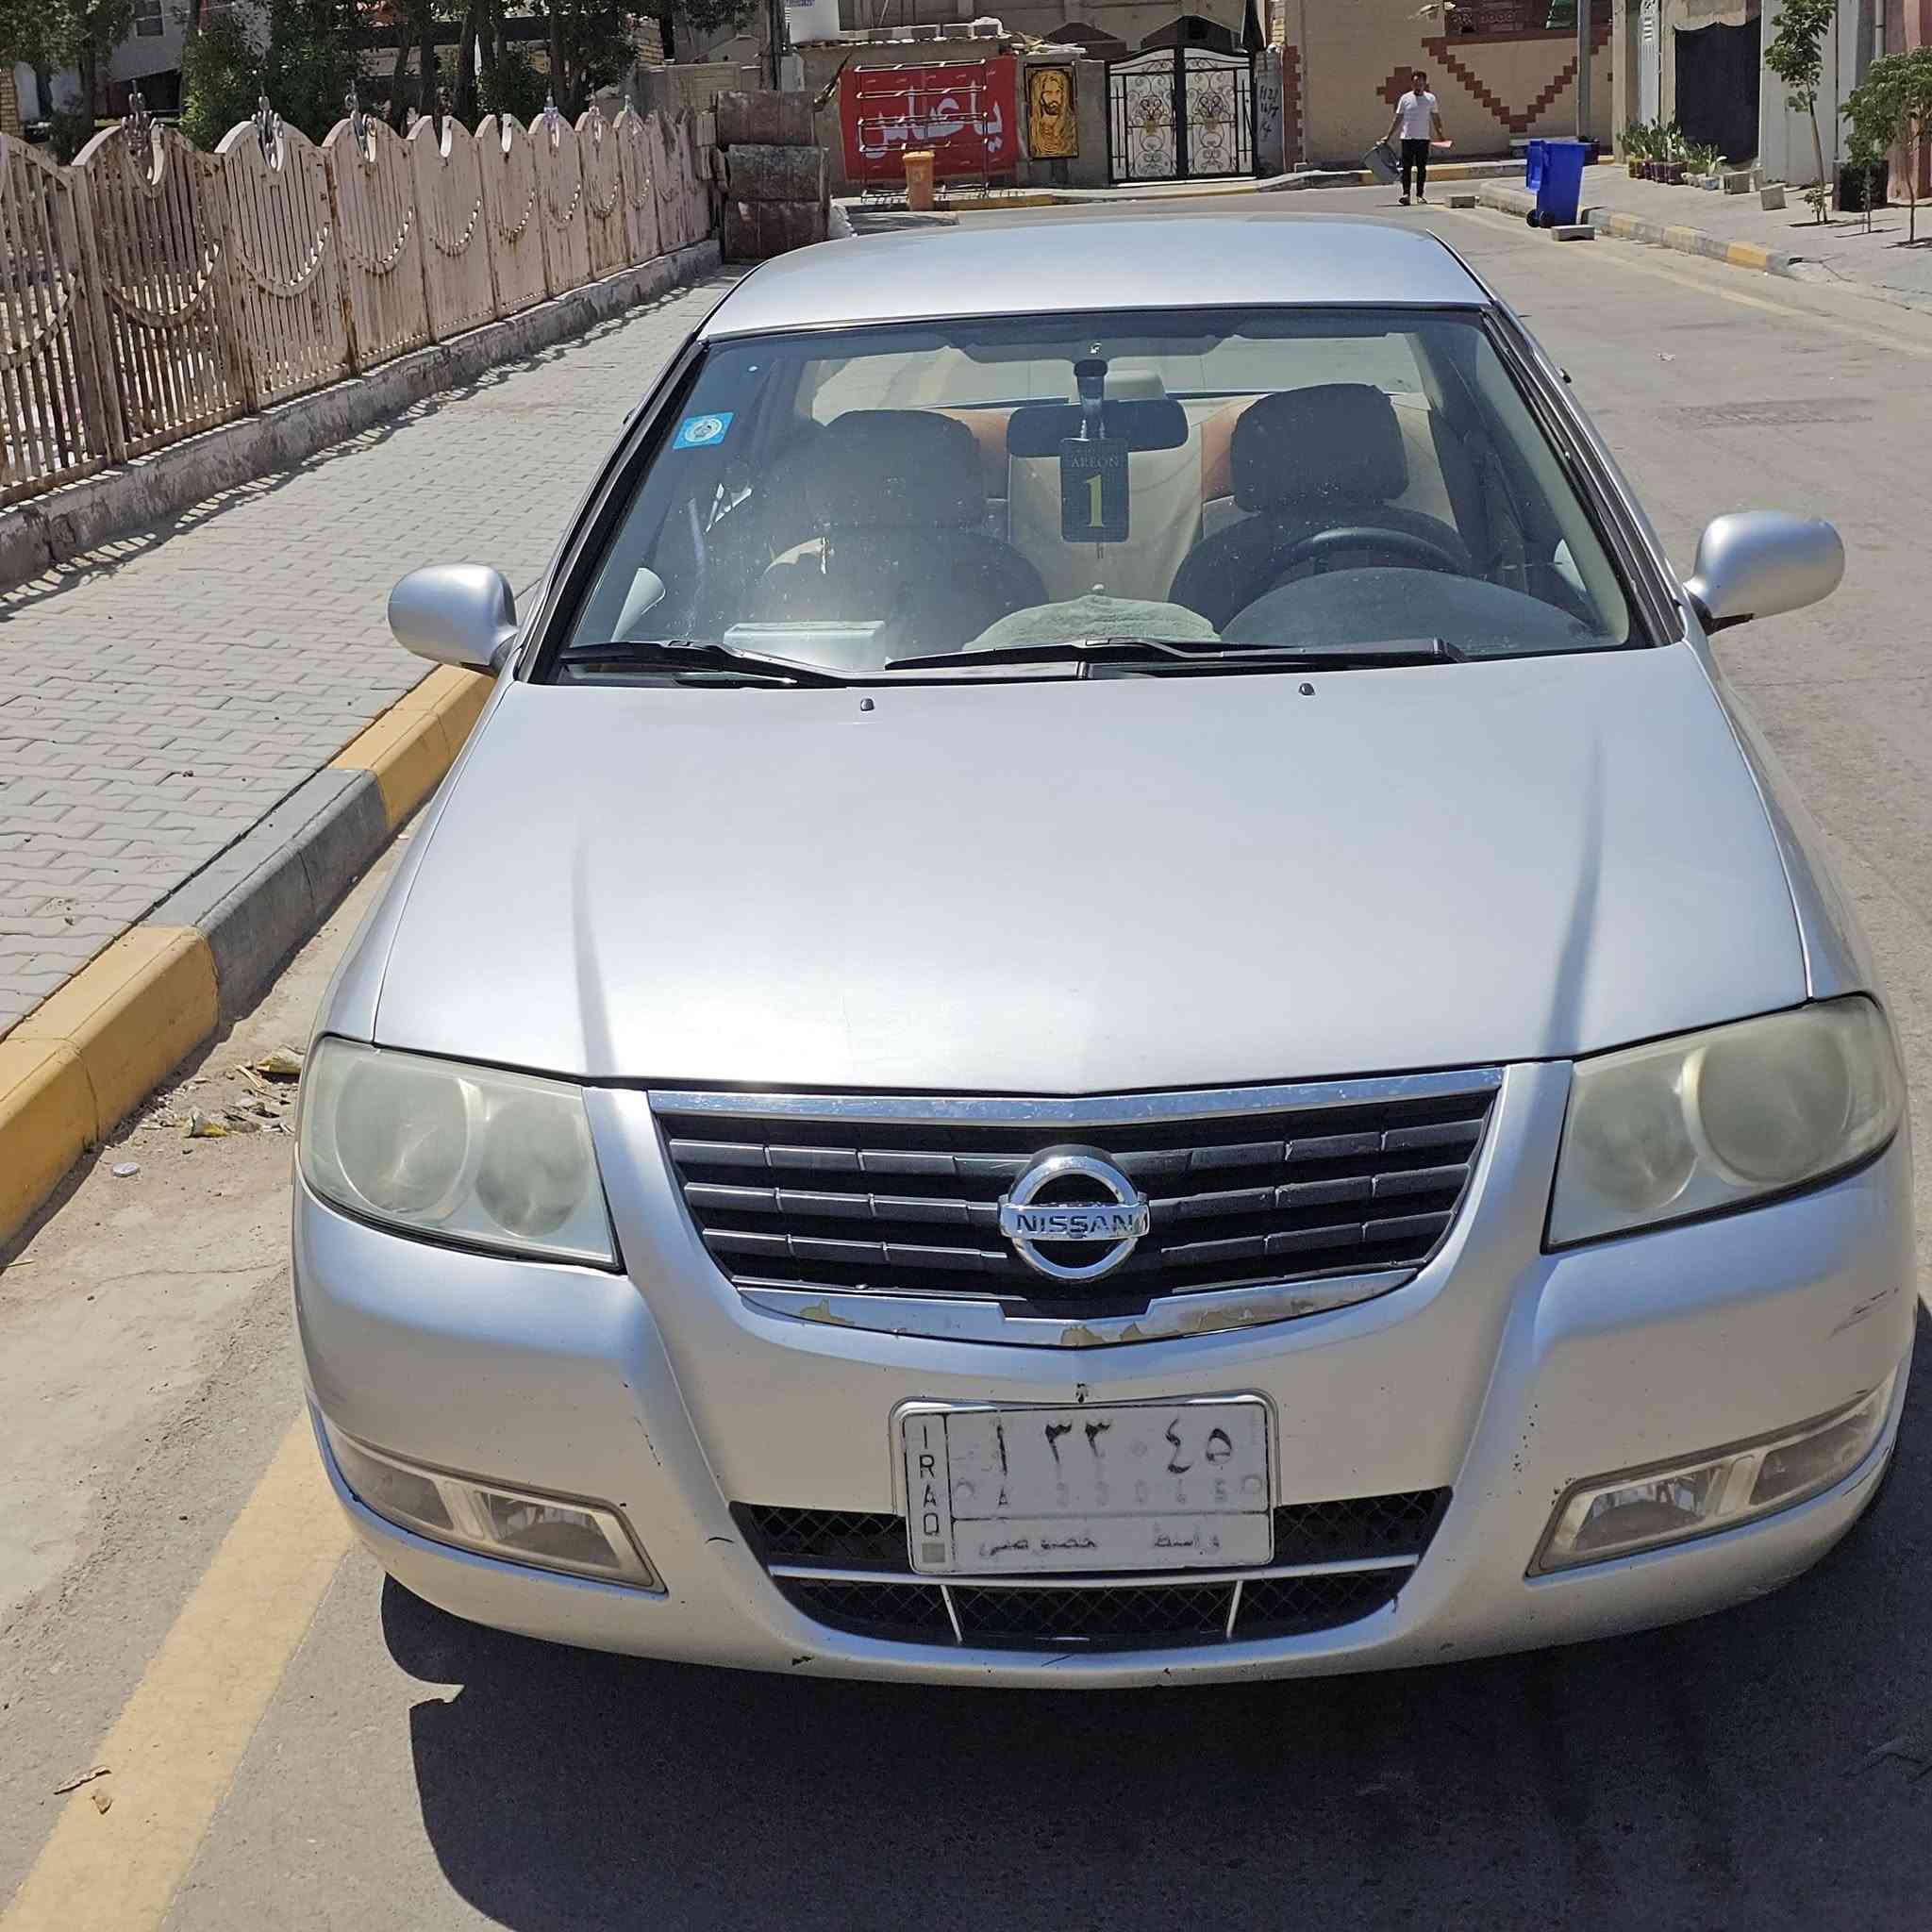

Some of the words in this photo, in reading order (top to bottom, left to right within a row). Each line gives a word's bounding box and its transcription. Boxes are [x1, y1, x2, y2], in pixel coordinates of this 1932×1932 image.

[1085, 474, 1105, 528] 1
[1017, 1213, 1134, 1234] NISSAN
[918, 1424, 941, 1536] IRAQ
